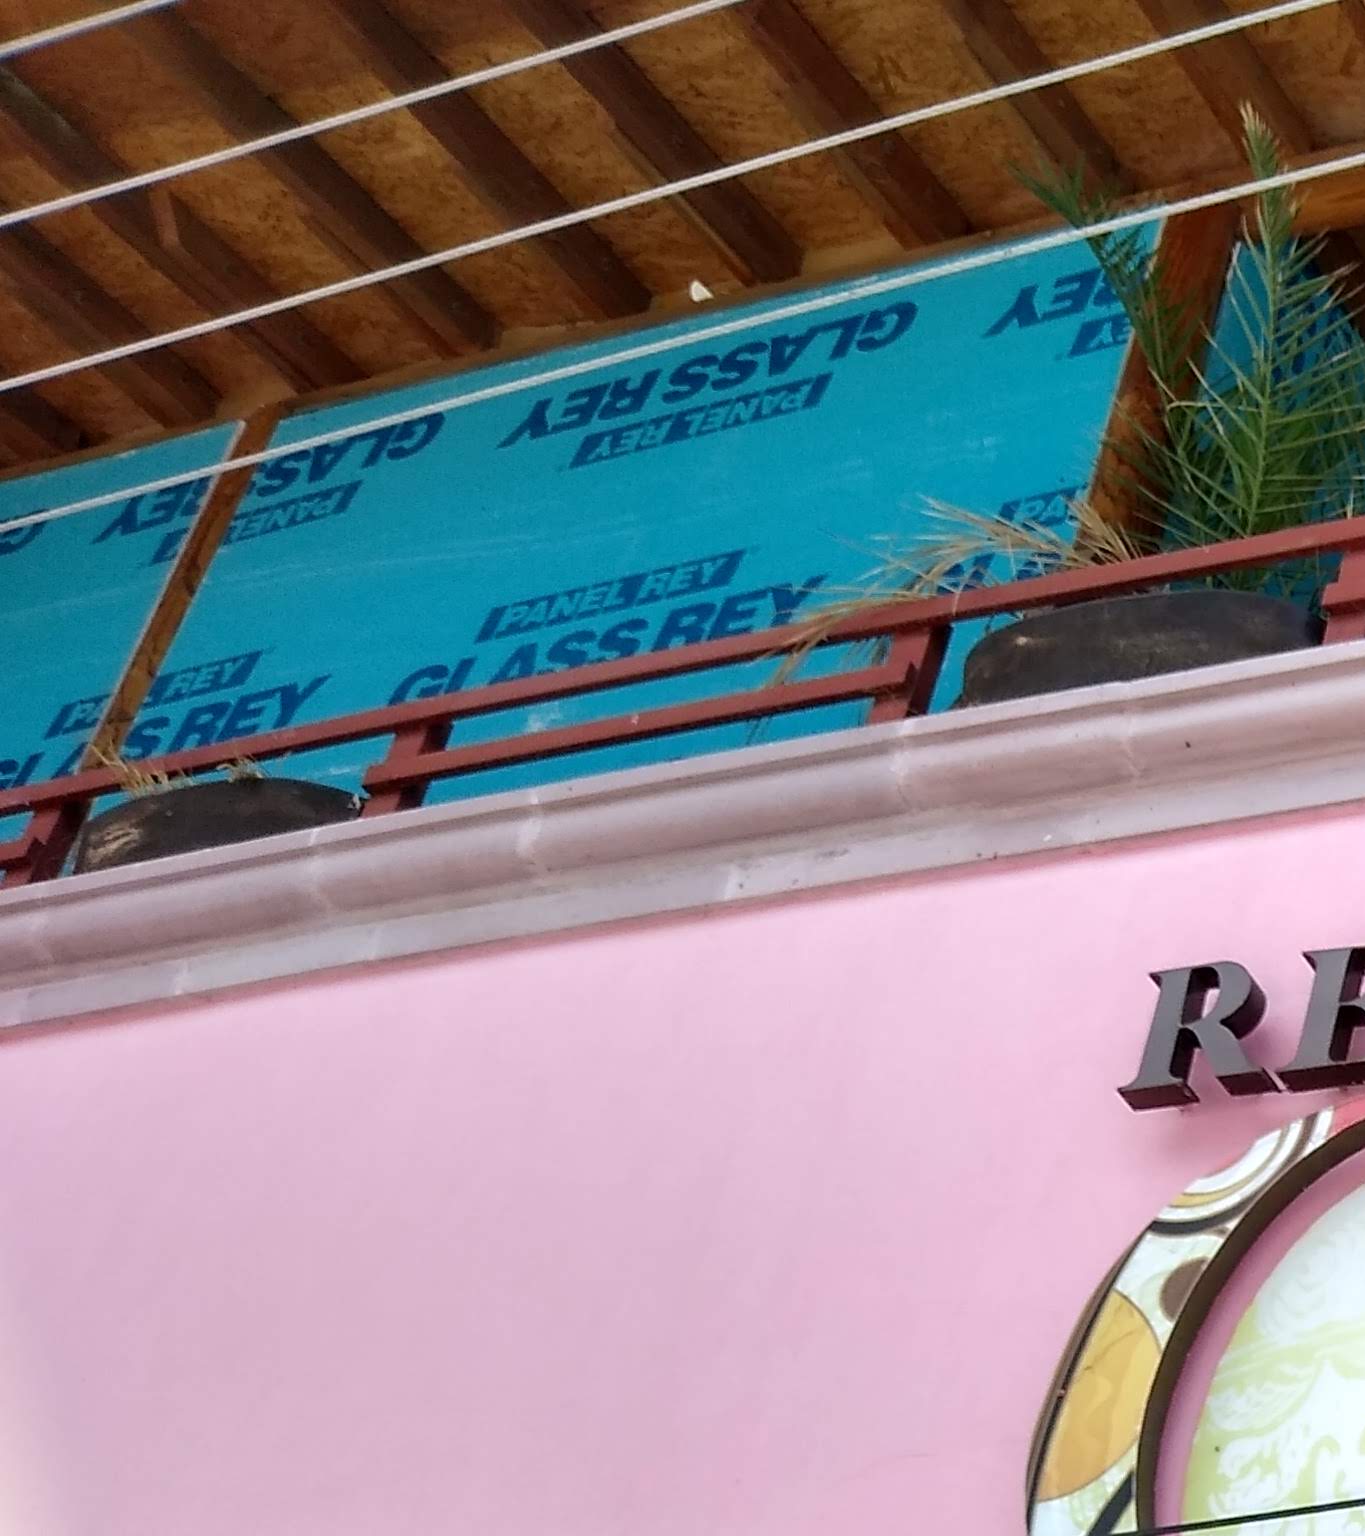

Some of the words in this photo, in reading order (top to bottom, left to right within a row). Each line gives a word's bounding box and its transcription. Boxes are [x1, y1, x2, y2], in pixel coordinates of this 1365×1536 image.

[661, 301, 919, 404] GLASS
[497, 369, 661, 449] REY
[687, 383, 806, 438] PANEL
[499, 580, 626, 631] PANEL
[639, 556, 729, 602] REY
